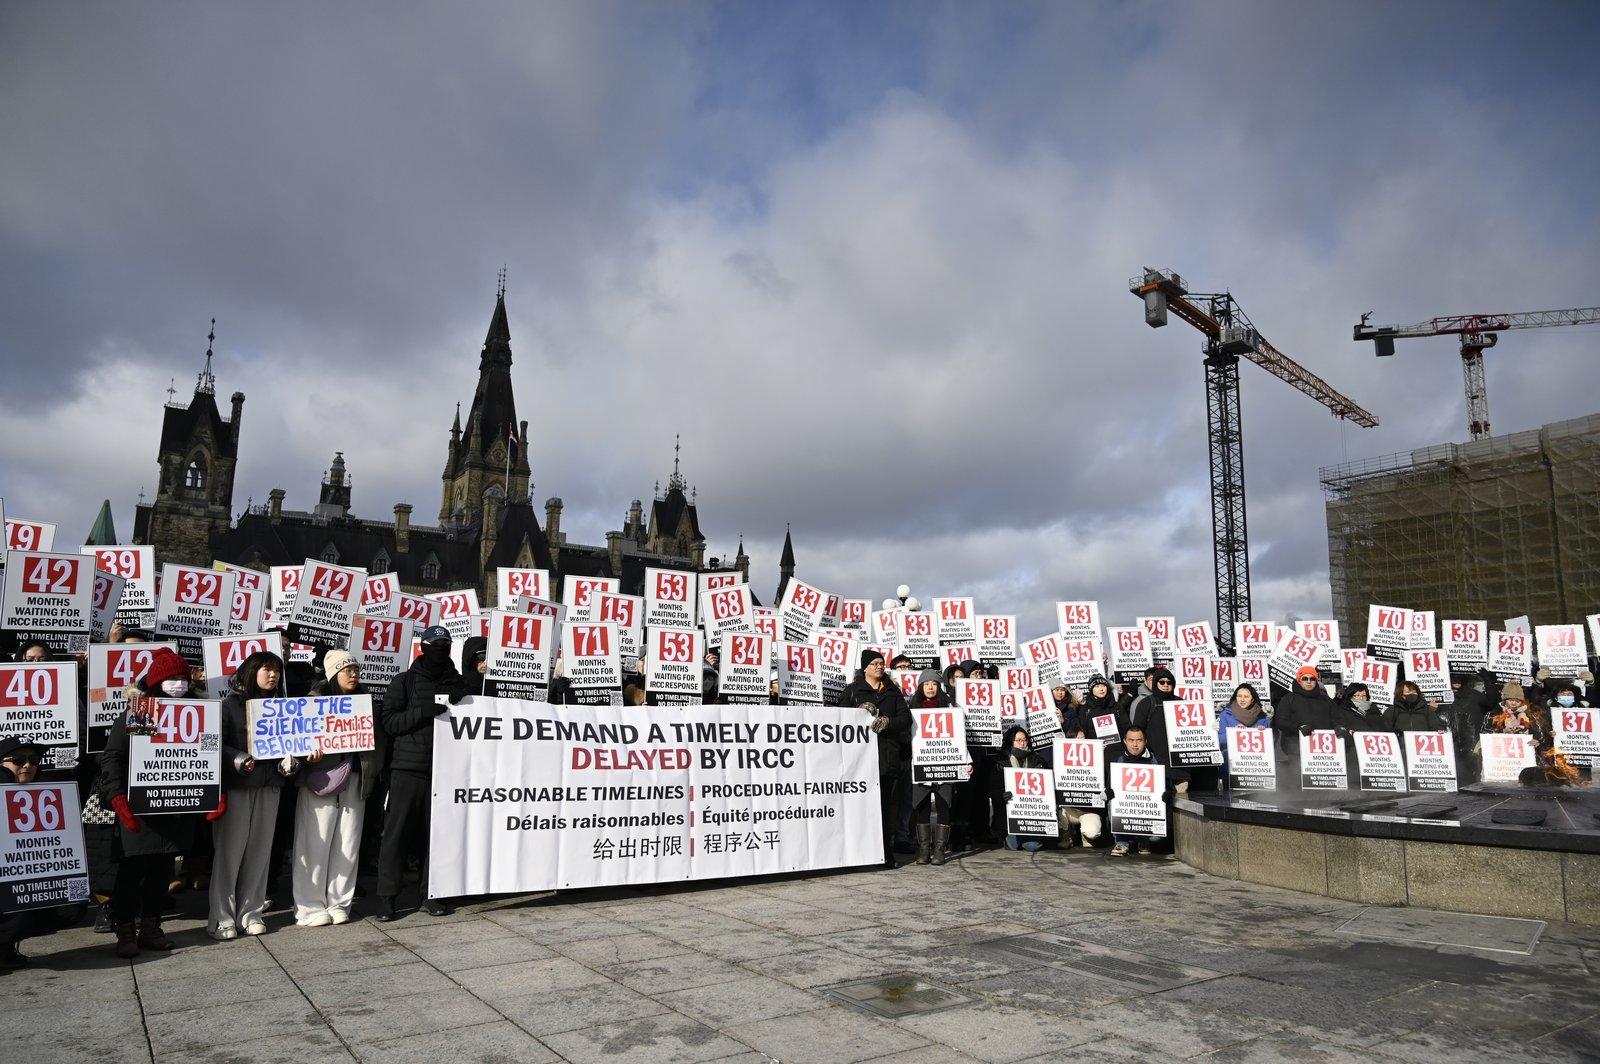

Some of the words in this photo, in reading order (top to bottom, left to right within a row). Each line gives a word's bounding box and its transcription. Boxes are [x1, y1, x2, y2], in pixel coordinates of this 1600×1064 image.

[101, 551, 135, 578] 39
[29, 558, 72, 593] 42
[315, 569, 349, 602] 42
[512, 573, 536, 595] 34
[181, 572, 217, 605] 32
[363, 579, 387, 605] 19
[660, 574, 684, 600] 53
[27, 597, 70, 606] MONTHS
[312, 600, 343, 611] MONTHS
[442, 595, 466, 619] 22
[716, 591, 741, 619] 68
[794, 584, 817, 611] 33
[15, 607, 58, 617] WAITING
[61, 608, 80, 617] FOR
[177, 606, 213, 616] MONTHS
[302, 606, 332, 619] WAITING
[333, 612, 348, 622] FOR
[400, 600, 427, 627] 22
[605, 598, 629, 626] 15
[845, 604, 861, 622] 19
[945, 601, 962, 619] 17
[1068, 605, 1088, 623] 43
[1382, 610, 1400, 629] 70
[7, 617, 30, 626] IRCC
[32, 617, 85, 627] RESPONSE
[160, 624, 180, 632] IRCC
[181, 625, 224, 636] RESPONSE
[167, 615, 203, 625] WAITING
[205, 619, 221, 627] FOR
[908, 615, 928, 635] 33
[986, 618, 1006, 638] 38
[1148, 620, 1166, 638] 29
[16, 633, 28, 641] NO
[367, 620, 396, 652] 31
[507, 617, 534, 649] 11
[578, 628, 605, 656] 71
[1119, 631, 1142, 650] 65
[1186, 625, 1204, 647] 63
[1246, 624, 1265, 642] 27
[1309, 624, 1327, 641] 16
[1454, 623, 1476, 641] 36
[1551, 628, 1572, 646] 37
[664, 633, 690, 662] 53
[734, 636, 759, 665] 34
[821, 639, 844, 665] 68
[1032, 640, 1054, 661] 30
[1067, 641, 1093, 662] 55
[1288, 637, 1313, 661] 35
[1501, 635, 1521, 654] 28
[496, 660, 526, 669] WAITING
[527, 662, 542, 670] FOR
[504, 651, 535, 661] MONTHS
[791, 646, 811, 672] 51
[1415, 653, 1437, 672] 31
[113, 650, 153, 685] 42
[507, 670, 544, 680] RESPONSE
[600, 667, 613, 675] FOR
[654, 672, 681, 681] WAITING
[661, 664, 689, 672] MONTHS
[1185, 657, 1203, 677] 62
[1214, 661, 1230, 680] 72
[1245, 659, 1261, 679] 23
[1366, 663, 1386, 683] 11
[6, 670, 52, 705] 40
[665, 682, 698, 690] RESPONSE
[736, 684, 766, 692] RESPONSE
[1009, 669, 1030, 689] 30
[968, 683, 989, 706] 33
[6, 710, 53, 720] MONTHS
[262, 698, 307, 718] STOP
[314, 697, 352, 715] THE
[1178, 704, 1202, 726] 34
[158, 704, 199, 743] 40
[450, 717, 503, 740] WE
[513, 718, 639, 744] DEMAND
[647, 723, 666, 743] A
[670, 723, 760, 743] TIMELY
[767, 723, 870, 744] DECISION
[925, 713, 950, 738] 41
[1566, 711, 1588, 732] 37
[314, 732, 375, 751] TOGETHER
[1239, 731, 1264, 752] 35
[1312, 733, 1332, 753] 18
[1366, 735, 1390, 755] 36
[1418, 735, 1442, 755] 21
[155, 748, 198, 758] MONTHS
[572, 747, 692, 770] DELAYED
[700, 749, 732, 769] BY
[737, 748, 795, 769] IRCC
[1066, 743, 1090, 766] 40
[144, 760, 187, 770] WAITING
[189, 760, 209, 769] FOR
[136, 772, 160, 782] IRCC
[161, 771, 214, 781] RESPONSE
[1018, 772, 1042, 796] 43
[1125, 768, 1151, 792] 22
[160, 788, 204, 797] TIMELINES
[454, 787, 588, 803] REASONABLE
[592, 785, 684, 800] TIMELINES
[702, 783, 801, 798] PROCEDURAL
[804, 781, 867, 794] FAIRNESS
[13, 790, 59, 832] 36
[163, 798, 200, 807] RESULTS
[506, 815, 567, 831] Délais
[573, 811, 684, 829] raisonnables
[702, 806, 750, 826] Équité
[753, 805, 835, 824] procédurale
[16, 836, 61, 849] MONTHS
[593, 835, 682, 860] 给出时限
[704, 830, 780, 854] 程序公平
[5, 849, 51, 863] WAITING
[53, 848, 73, 859] FOR
[0, 865, 25, 877] IRCC
[26, 859, 81, 874] RESPONSE
[12, 884, 25, 894] NO
[17, 894, 30, 904] NO
[32, 890, 69, 902] RESULTS
